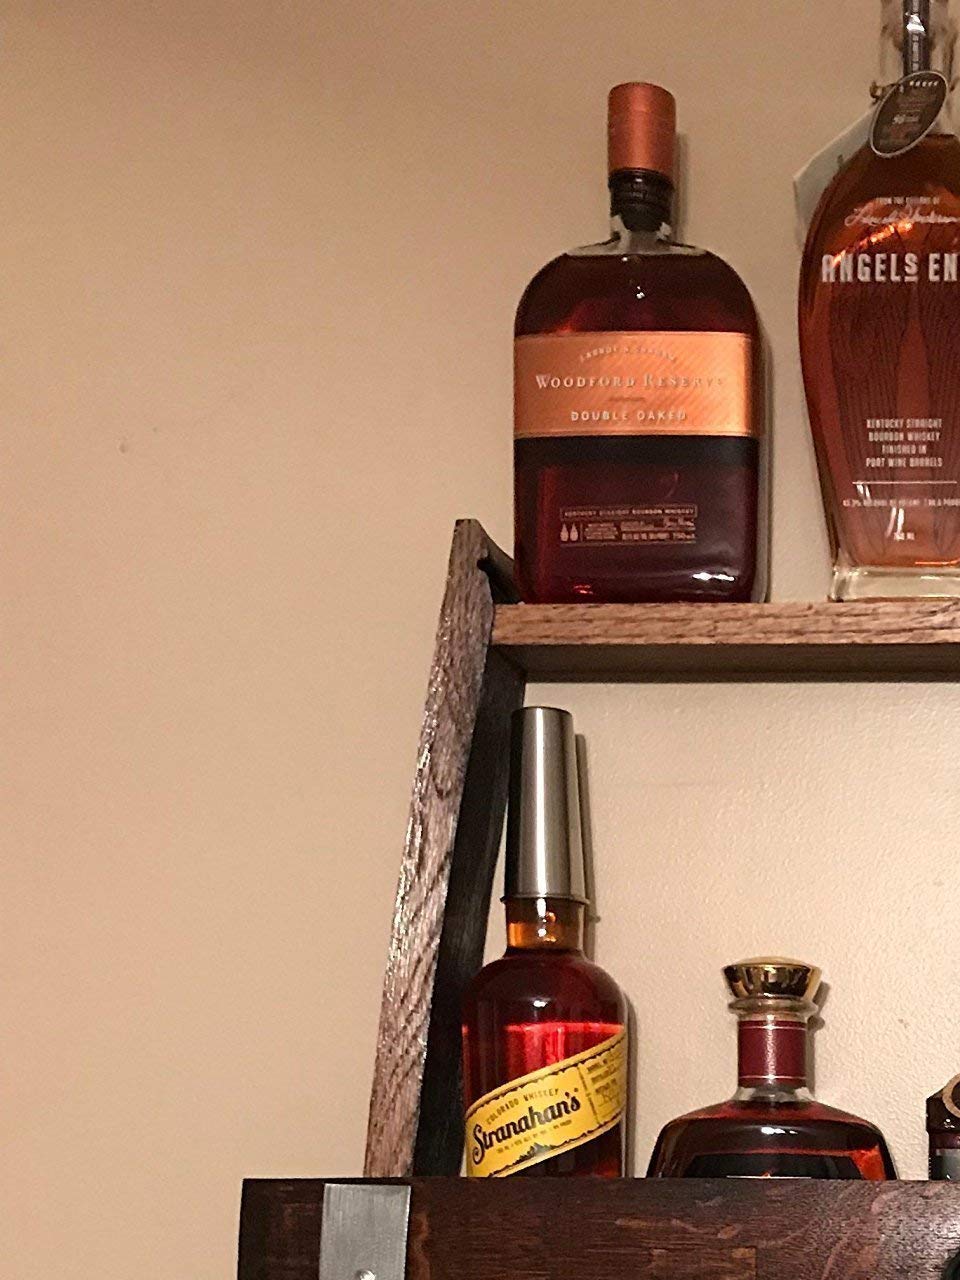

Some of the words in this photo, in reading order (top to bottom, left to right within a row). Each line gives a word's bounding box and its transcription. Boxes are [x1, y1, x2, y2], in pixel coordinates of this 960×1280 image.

[535, 374, 635, 390] WOODFORD
[643, 372, 724, 391] RESERVE
[570, 411, 628, 422] DOUBLE
[637, 410, 687, 421] OAKED
[485, 1097, 520, 1126] COLORADO
[523, 1087, 560, 1102] WHISKEY
[472, 1091, 581, 1164] Stranahan's
